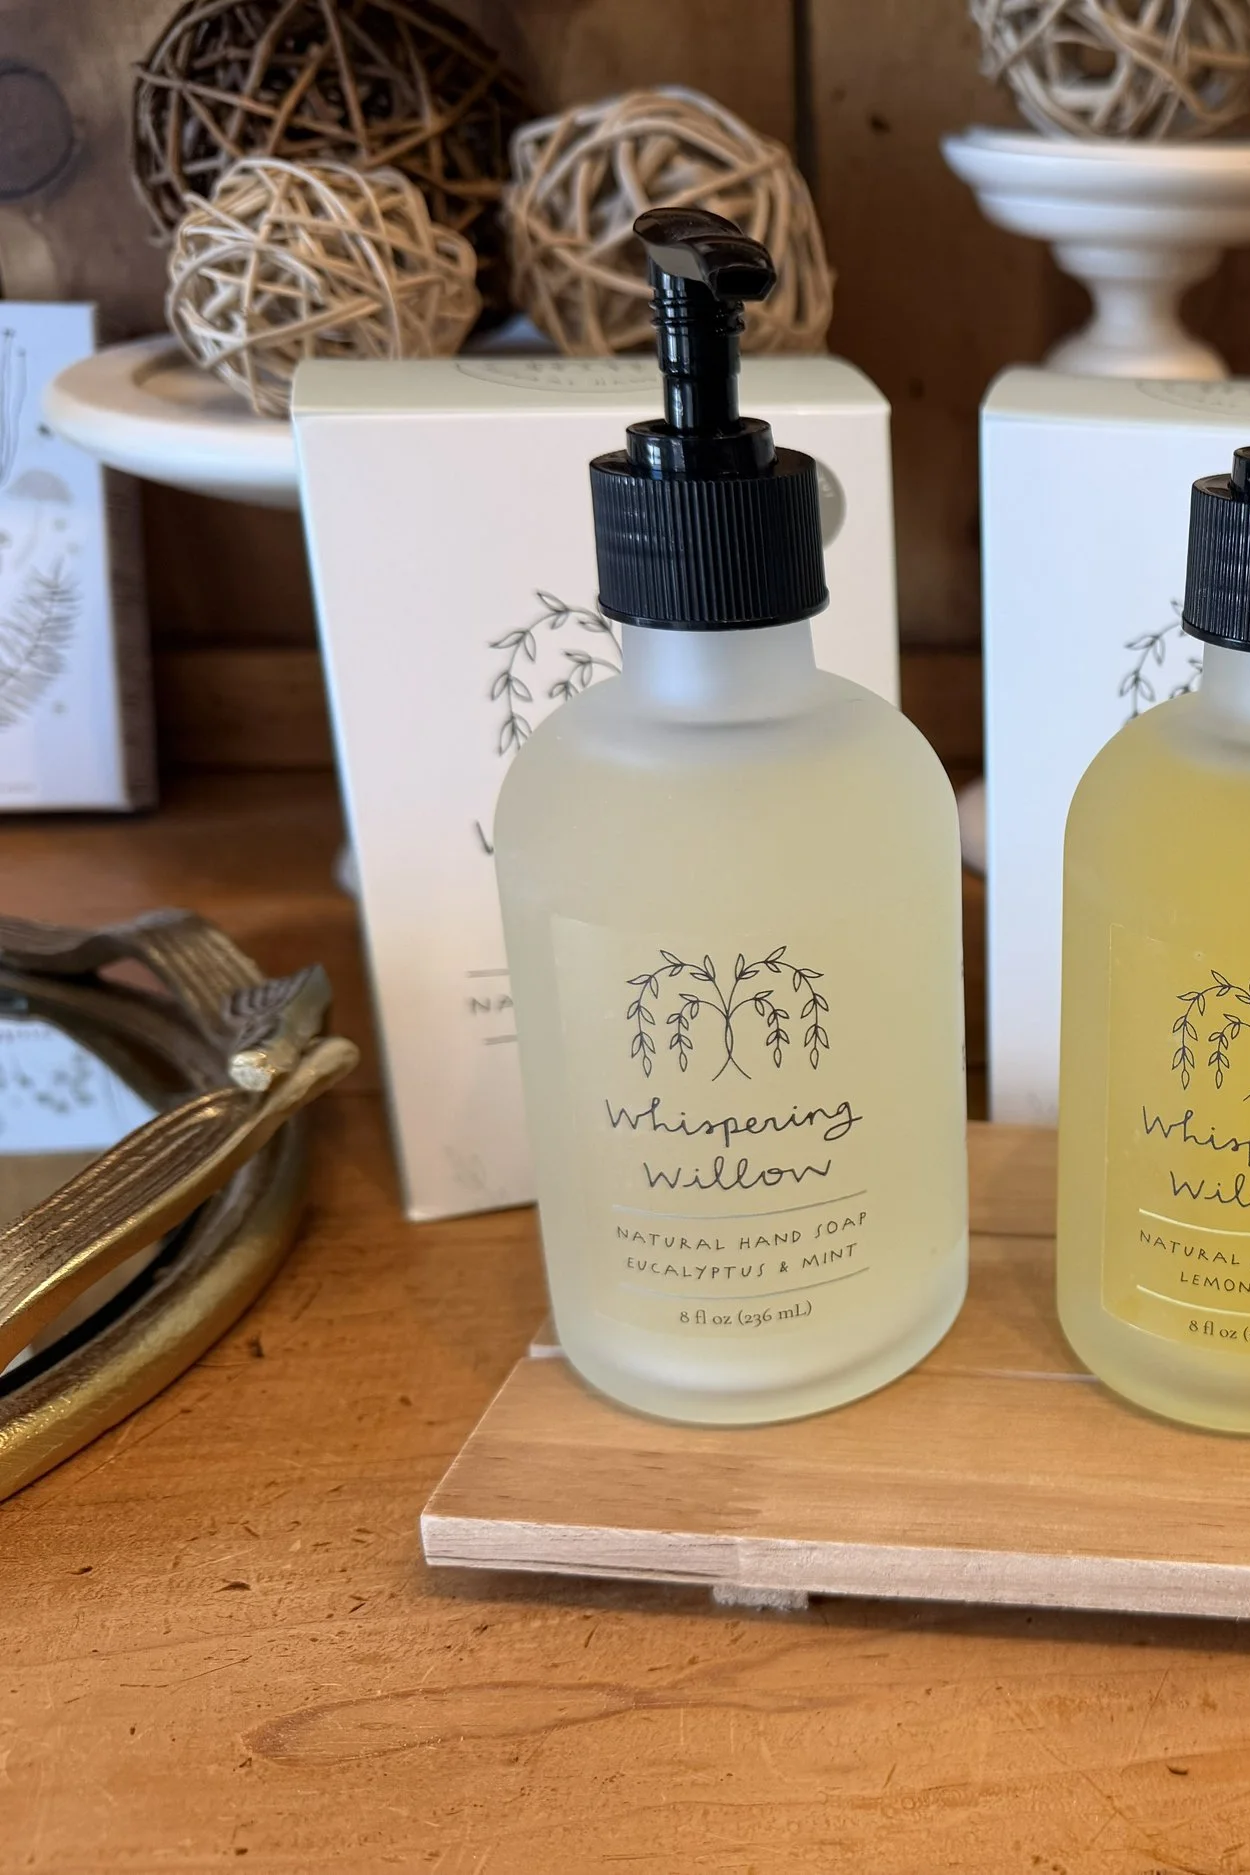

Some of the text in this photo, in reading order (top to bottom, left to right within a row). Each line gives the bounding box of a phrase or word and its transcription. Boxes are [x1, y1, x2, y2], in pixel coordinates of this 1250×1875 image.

[604, 1096, 864, 1149] Whispering
[642, 1155, 832, 1191] Willow
[617, 1212, 867, 1252] NATURAL HAND SOAP
[1139, 1228, 1241, 1266] NATURAL
[626, 1243, 858, 1280] EUCALYPTUS & MINT
[680, 1299, 813, 1327] 8 fl oz (236 mL)
[1188, 1319, 1200, 1333] 8
[1203, 1320, 1215, 1337] fl
[1218, 1328, 1238, 1340] oz
